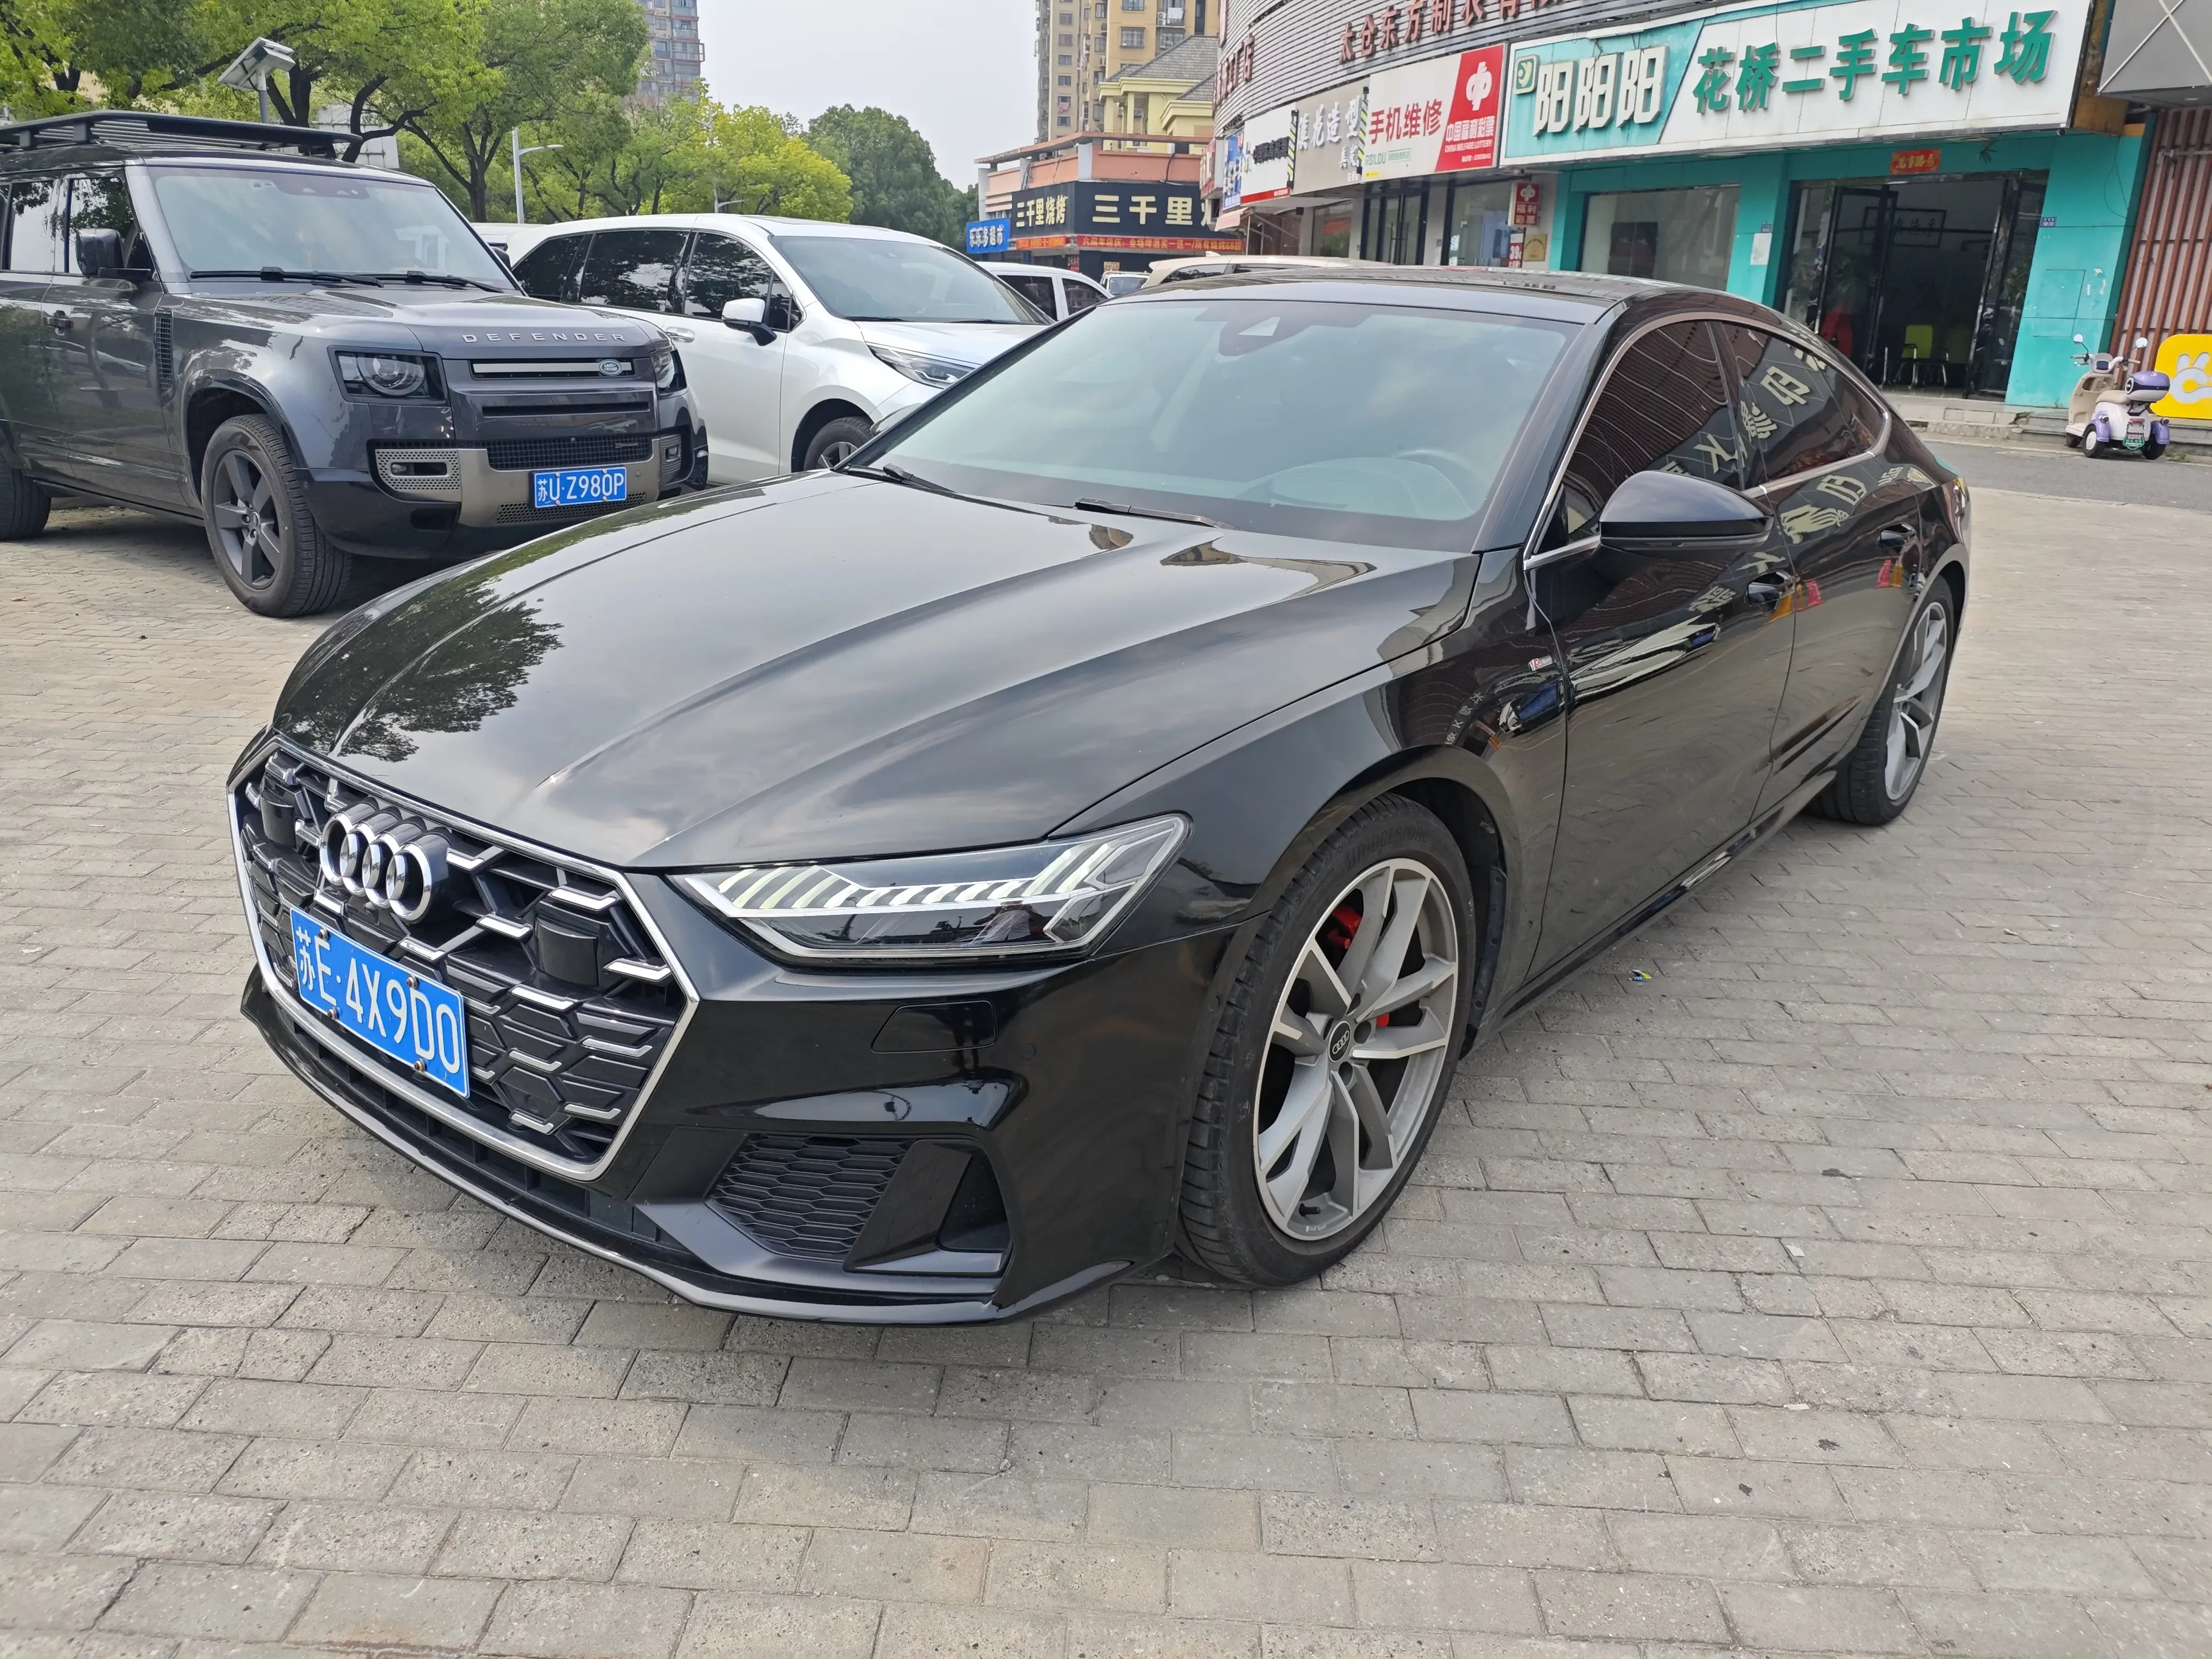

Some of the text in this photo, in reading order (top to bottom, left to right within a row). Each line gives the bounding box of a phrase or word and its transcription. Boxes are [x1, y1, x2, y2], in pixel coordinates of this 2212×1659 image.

[1339, 0, 1561, 63] 太仓东方制衣
[1692, 10, 2058, 114] 花桥二手车市场
[1369, 99, 1442, 145] 手机维修
[1445, 116, 1495, 142] 中国福利彩票
[1016, 195, 1067, 227] 三千里烧烤
[462, 333, 626, 343] DEFENDER
[537, 473, 624, 502] 苏U·Z980P
[296, 926, 460, 1074] 苏E·4X9D0
